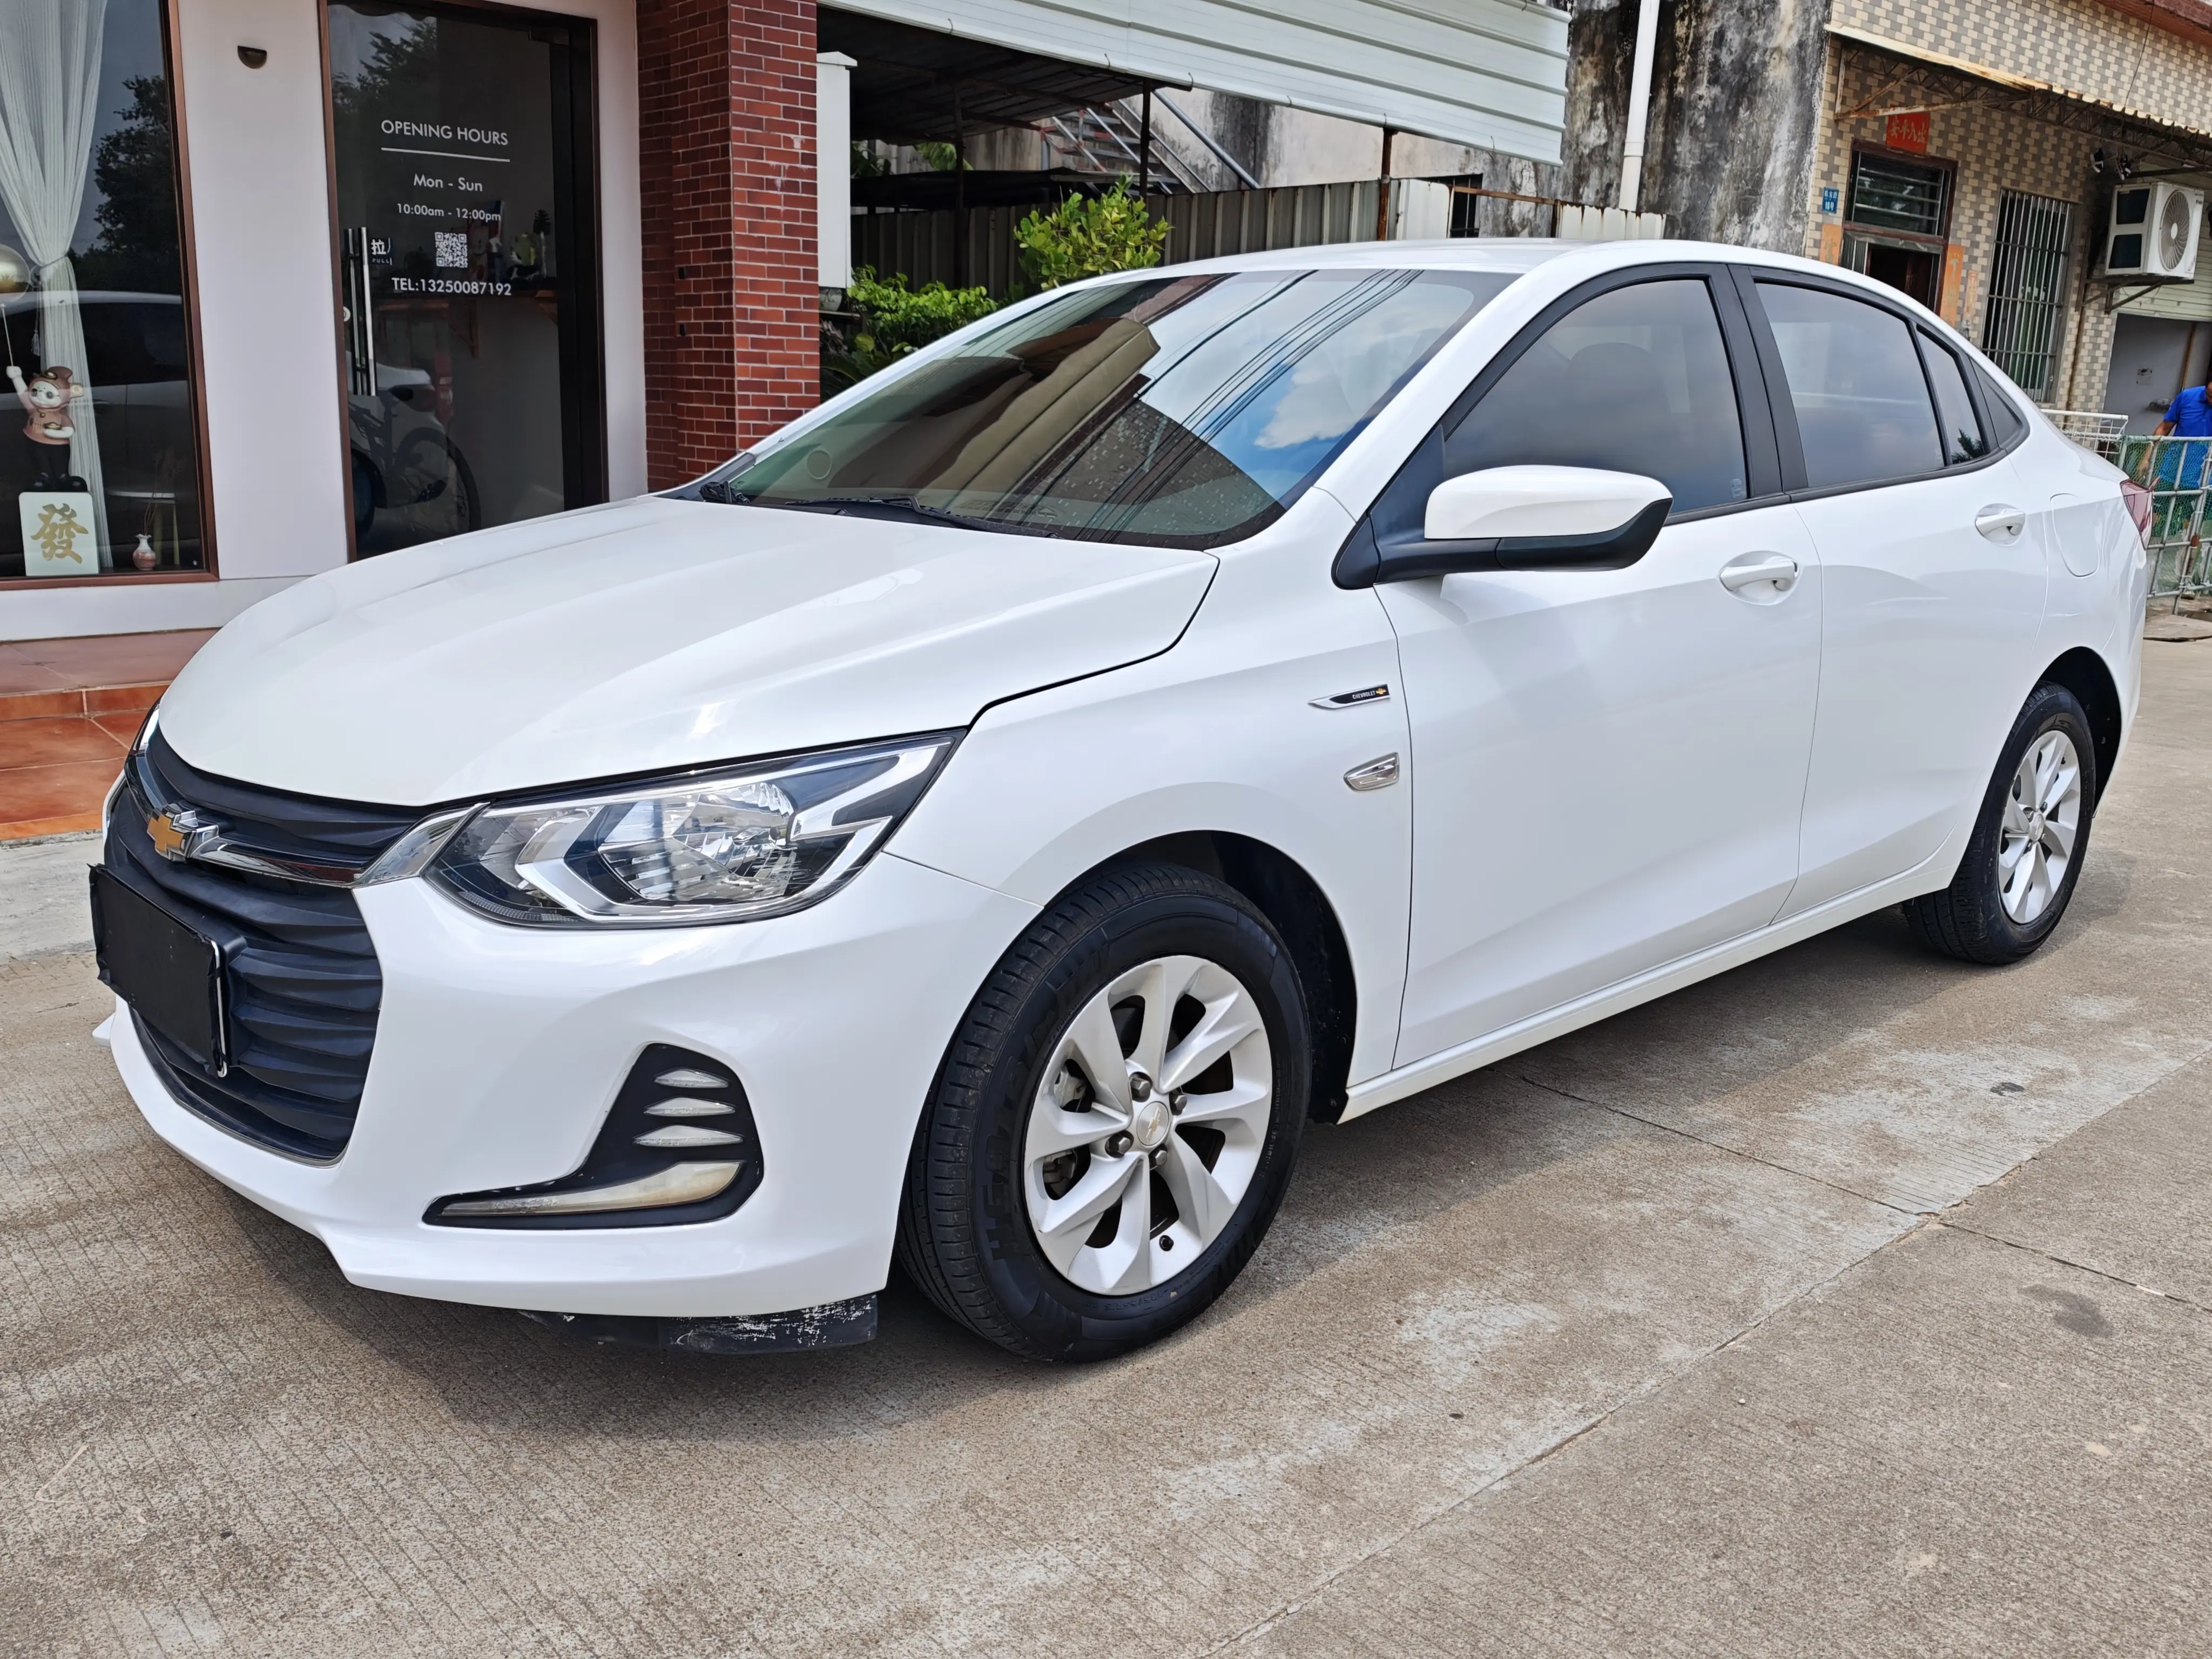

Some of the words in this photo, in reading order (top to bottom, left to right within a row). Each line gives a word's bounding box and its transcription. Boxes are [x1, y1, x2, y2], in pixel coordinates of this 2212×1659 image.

[381, 119, 453, 139] OPENING
[457, 127, 508, 145] HOURS
[414, 174, 443, 188] Mon
[458, 177, 483, 192] Sun
[397, 203, 444, 217] 10:00am
[456, 208, 501, 222] 12:00pm
[370, 239, 387, 255] 拉
[392, 277, 511, 296] TEL:13250087192
[31, 503, 89, 564] 發
[1352, 691, 1375, 699] CHEVROLET
